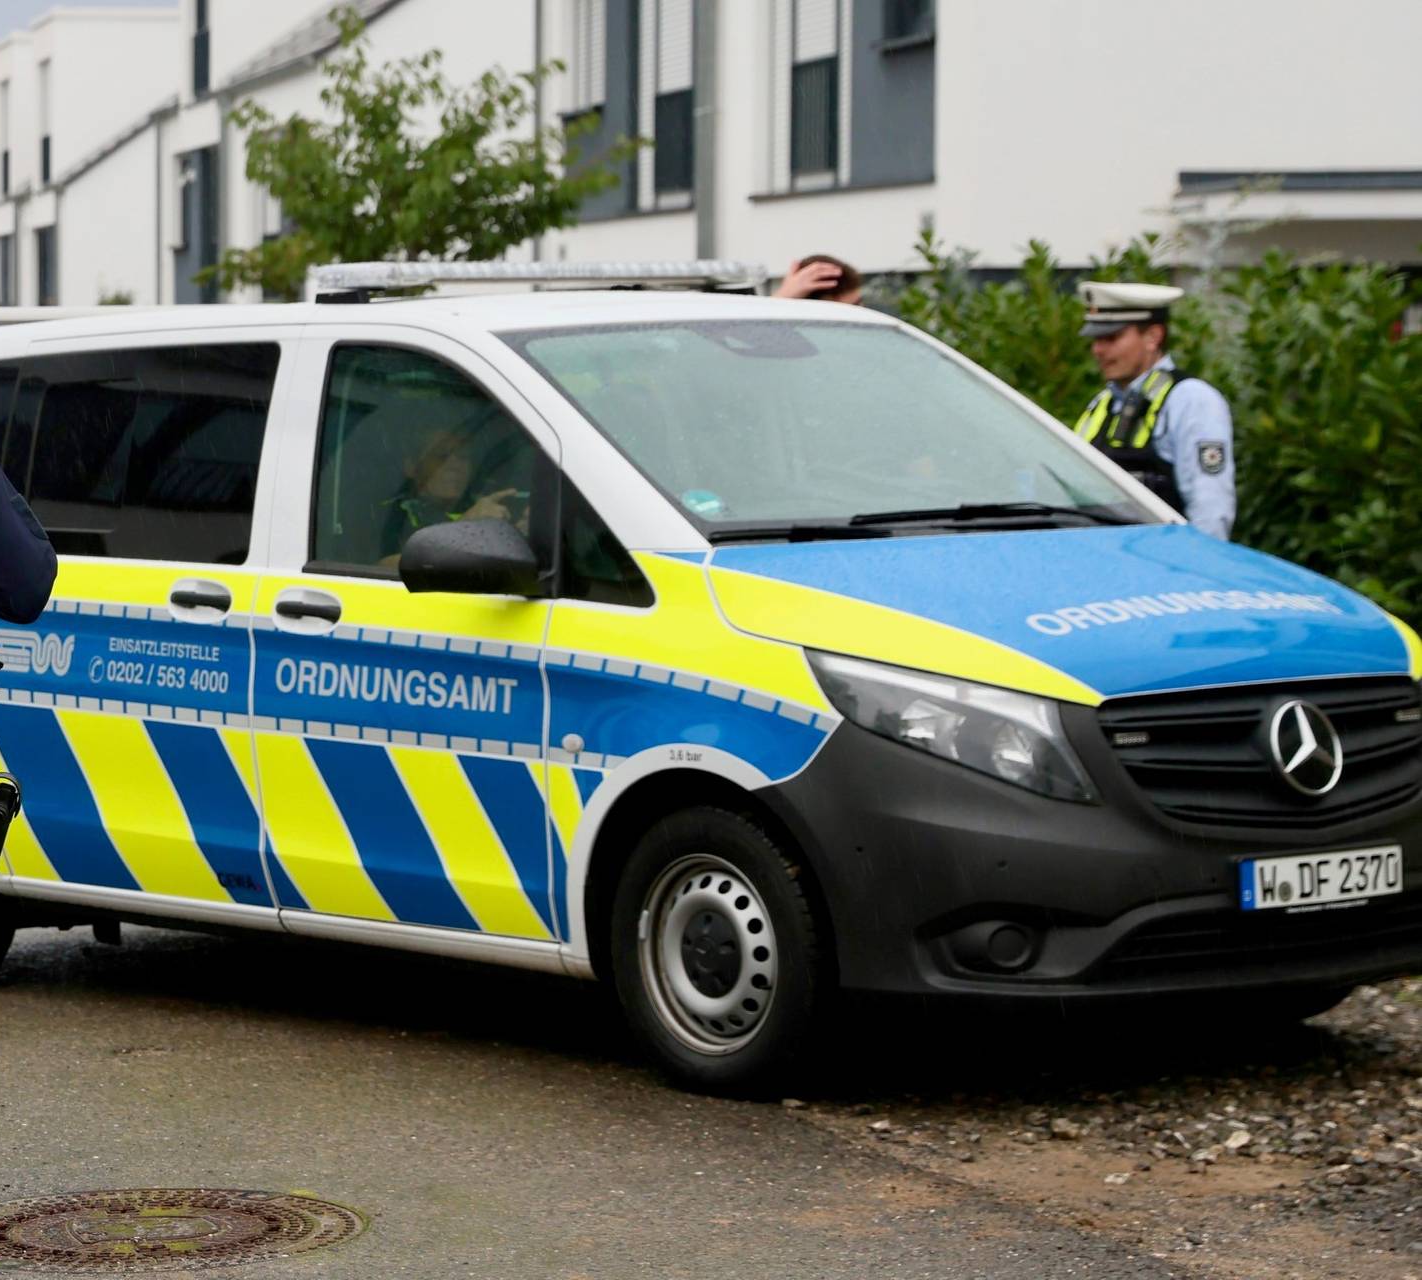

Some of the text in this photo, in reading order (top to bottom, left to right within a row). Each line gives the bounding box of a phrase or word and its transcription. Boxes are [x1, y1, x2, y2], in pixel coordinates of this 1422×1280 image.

[109, 636, 220, 662] EINSATZLEITSTELLE
[107, 660, 144, 685] 0202
[157, 665, 185, 689] 563
[189, 668, 229, 694] 4000
[275, 657, 519, 715] ORDNUNGSAMT
[1259, 865, 1277, 902] W
[1298, 860, 1331, 899] DF
[1338, 853, 1399, 894] 2370
